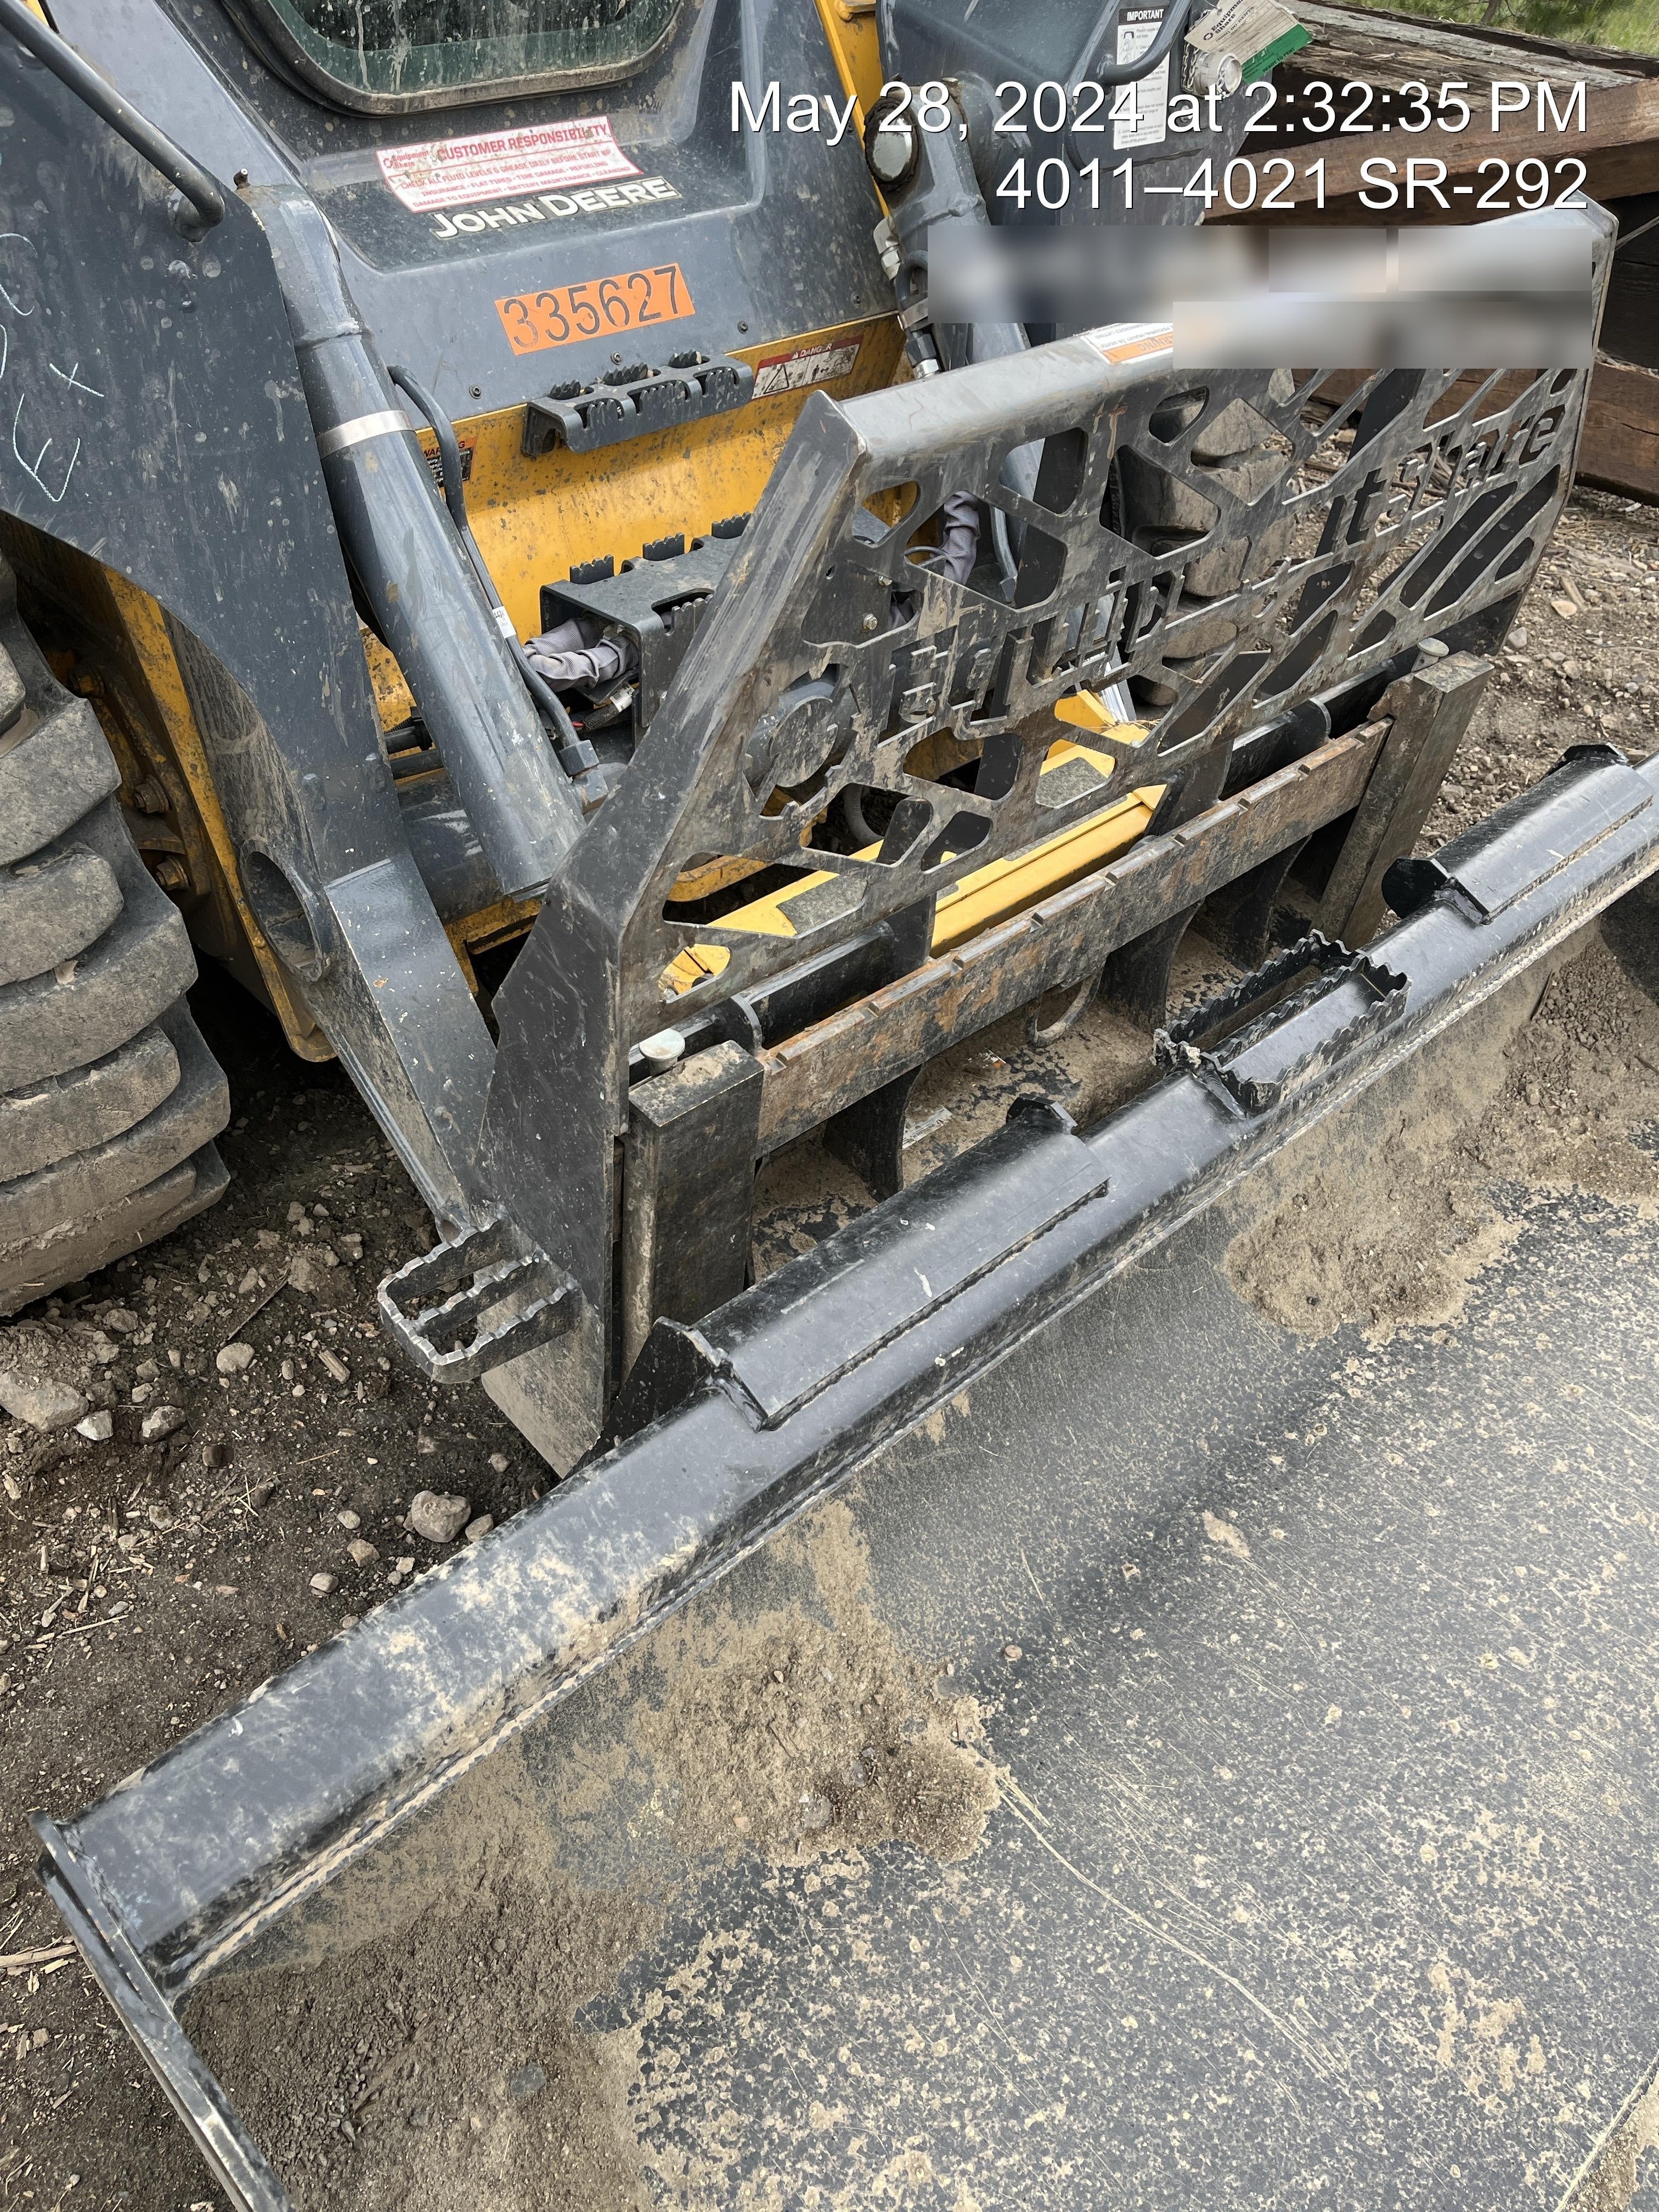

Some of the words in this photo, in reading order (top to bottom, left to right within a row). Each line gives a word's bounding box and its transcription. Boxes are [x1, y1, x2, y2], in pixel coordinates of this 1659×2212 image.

[1126, 9, 1164, 21] IMPORTANT
[1215, 14, 1235, 33] Share
[392, 151, 429, 162] Equipment
[437, 139, 506, 162] CUSTOMER
[508, 124, 607, 149] RESPONSIBILITY
[400, 179, 425, 189] CHECK
[428, 177, 441, 186] ALL
[442, 173, 465, 184] FLUID
[466, 169, 493, 179] LEVELS
[500, 162, 528, 173] GREASE
[529, 159, 549, 168] DAILY
[551, 155, 577, 164] BEFORE
[578, 151, 600, 160] START
[413, 198, 444, 207] DAMAGE
[458, 188, 503, 200] EQUIPMENT
[507, 182, 539, 191] BATTERY
[540, 172, 592, 185] MAINTENANCE
[595, 166, 630, 177] CLEANING
[421, 184, 466, 196] INSURANCE
[535, 168, 566, 178] DAMAGE
[569, 161, 608, 172] REFUELING
[435, 200, 546, 239] JOHN
[539, 177, 678, 217] DEERE
[503, 266, 680, 349] 335627
[1136, 333, 1173, 351] ARNING
